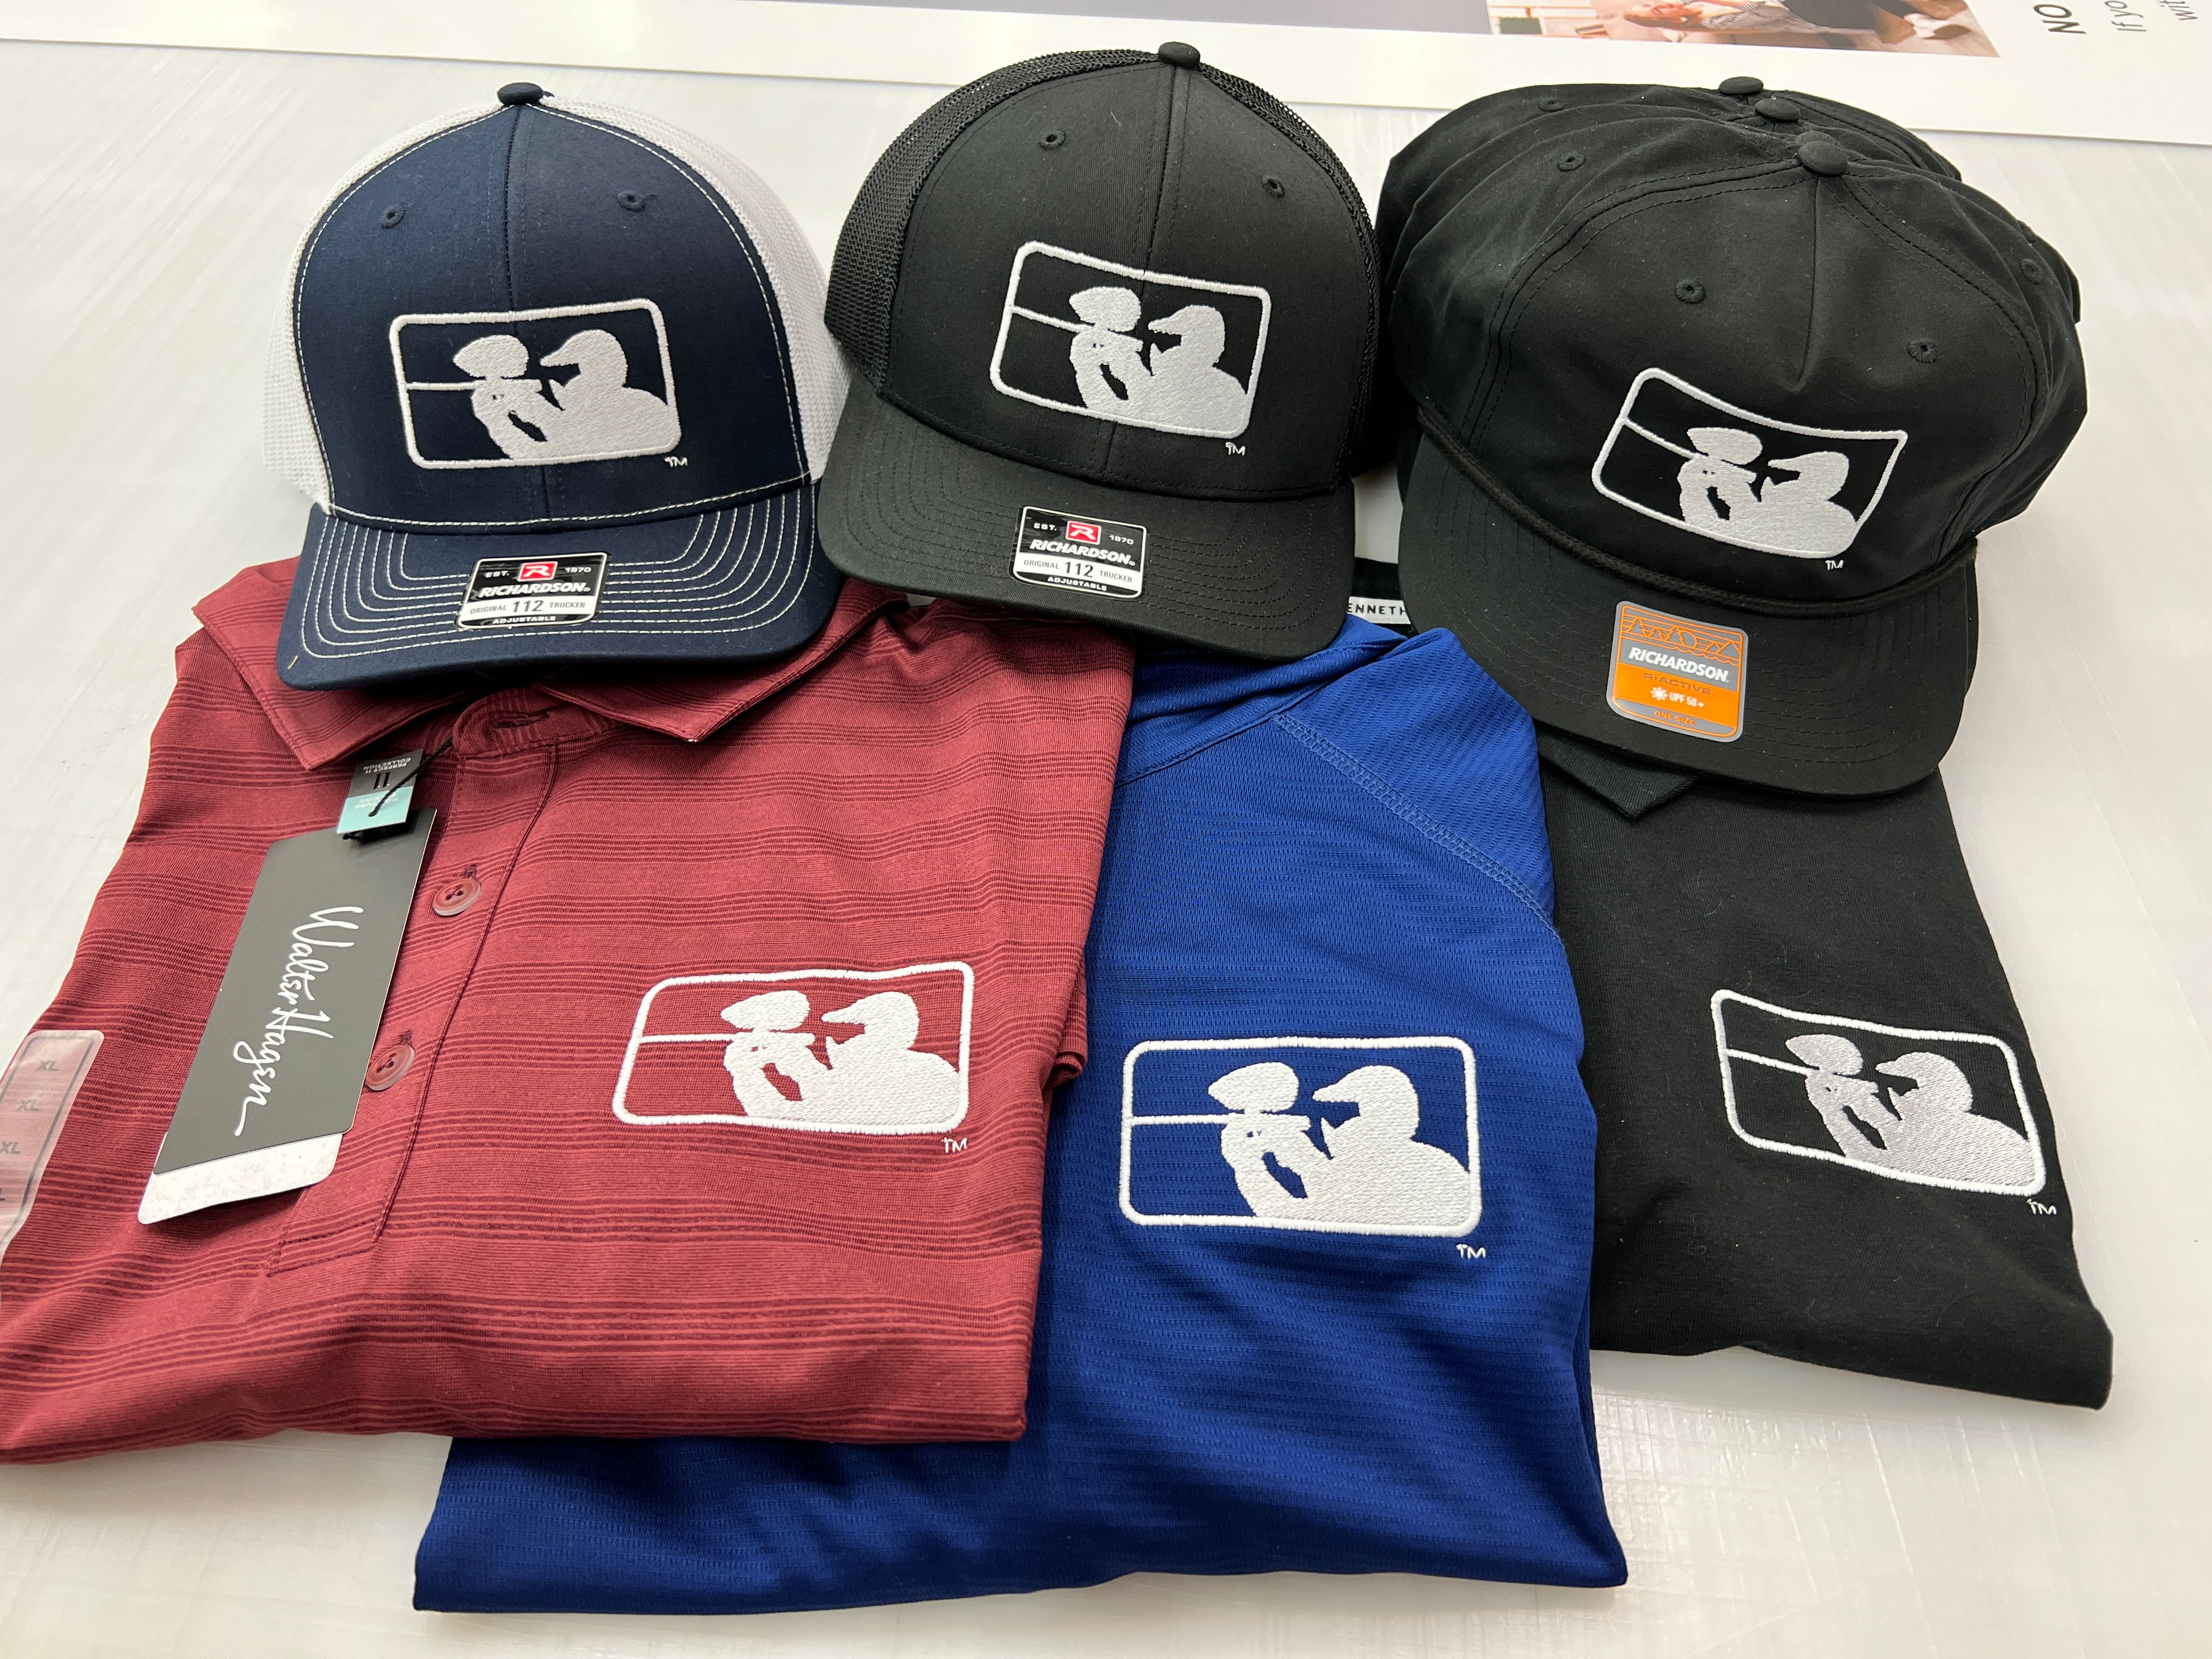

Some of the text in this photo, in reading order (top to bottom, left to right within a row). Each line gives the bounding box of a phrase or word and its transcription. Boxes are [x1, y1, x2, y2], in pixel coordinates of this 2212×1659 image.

[2034, 4, 2087, 34] NO
[2105, 1, 2147, 32] If yo
[1034, 522, 1057, 531] EST.
[1024, 559, 1132, 583] ORIGINAL 112 TRUCKER
[1047, 576, 1107, 591] ADJUSTABLE
[470, 605, 507, 614] ORIGINAL
[512, 600, 544, 613] 112
[493, 616, 557, 624] ADJUSTABLE
[1669, 692, 1685, 703] UPF
[1655, 710, 1695, 725] ONE SIZE
[356, 797, 399, 809] MOTURE
[35, 1060, 58, 1071] XL
[15, 1099, 40, 1111] XL
[0, 1141, 21, 1154] XL
[941, 1137, 967, 1153] TM
[2027, 1198, 2057, 1215] TM
[1455, 1243, 1486, 1259] TM
